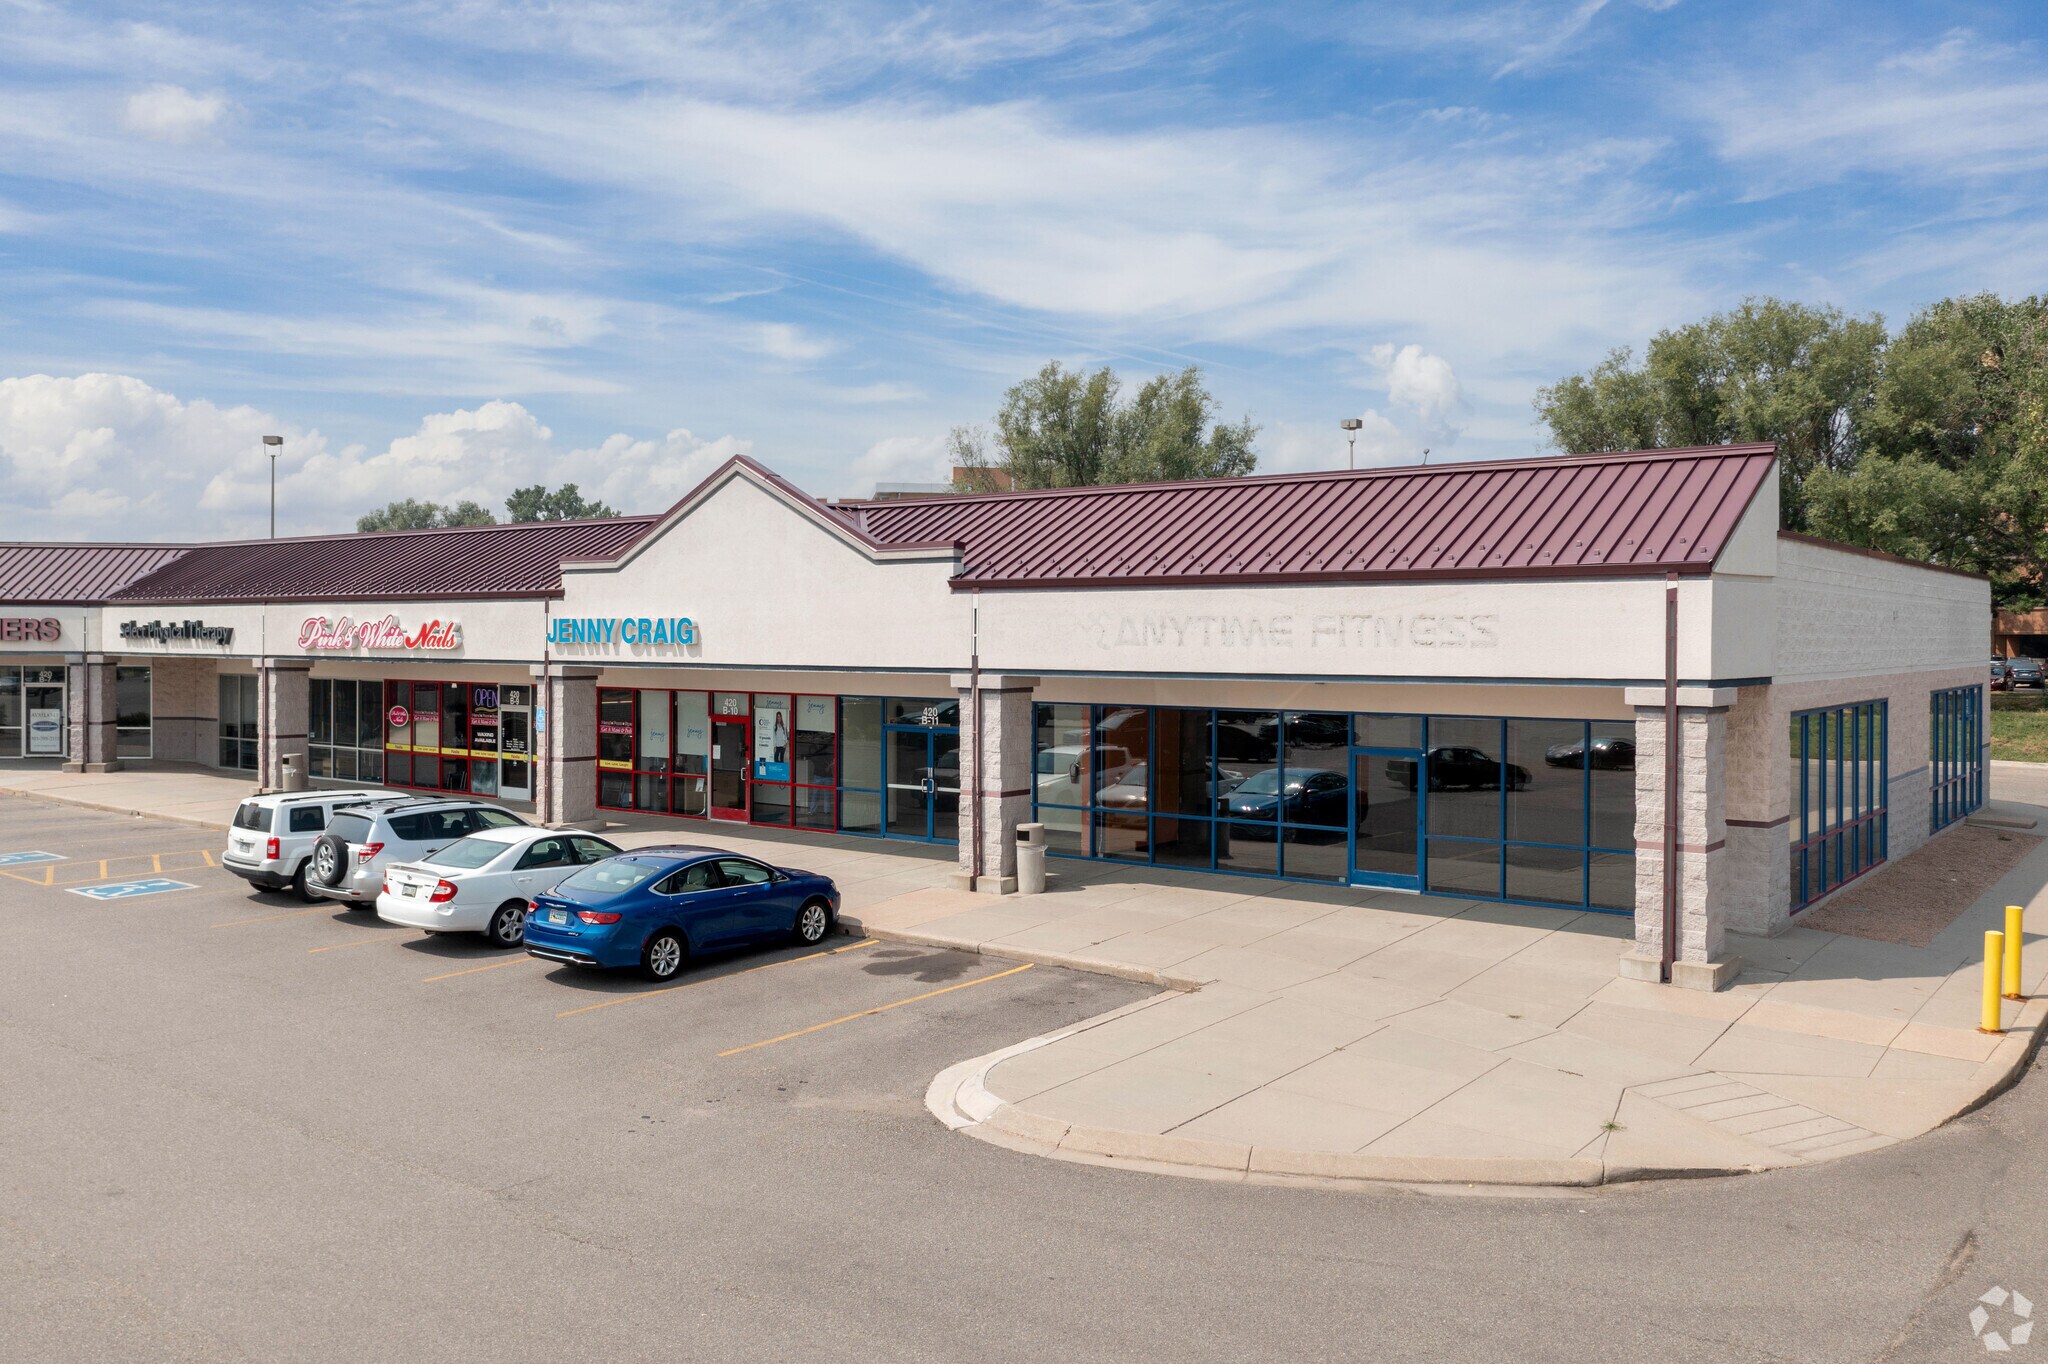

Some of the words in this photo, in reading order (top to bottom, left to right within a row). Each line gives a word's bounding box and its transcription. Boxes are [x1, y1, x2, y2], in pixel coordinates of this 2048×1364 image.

[0, 617, 60, 643] ERS
[120, 620, 146, 638] Select
[147, 620, 183, 643] Physical
[185, 620, 231, 645] Therapy
[299, 617, 344, 649] Pink
[344, 626, 358, 648] &
[359, 615, 404, 649] White
[405, 619, 456, 650] Nails
[547, 618, 616, 644] JENNY
[621, 617, 693, 645] CRAIG
[1115, 614, 1295, 649] ANYTIME
[1311, 613, 1498, 650] FITNESS
[475, 688, 498, 707] OPEN
[510, 697, 520, 705] B-9
[724, 698, 737, 707] 420
[722, 706, 738, 715] B-10
[807, 700, 825, 714] jenny
[922, 707, 938, 717] 420
[921, 716, 939, 725] B-11
[651, 728, 665, 742] jenny
[687, 725, 704, 738] jenny
